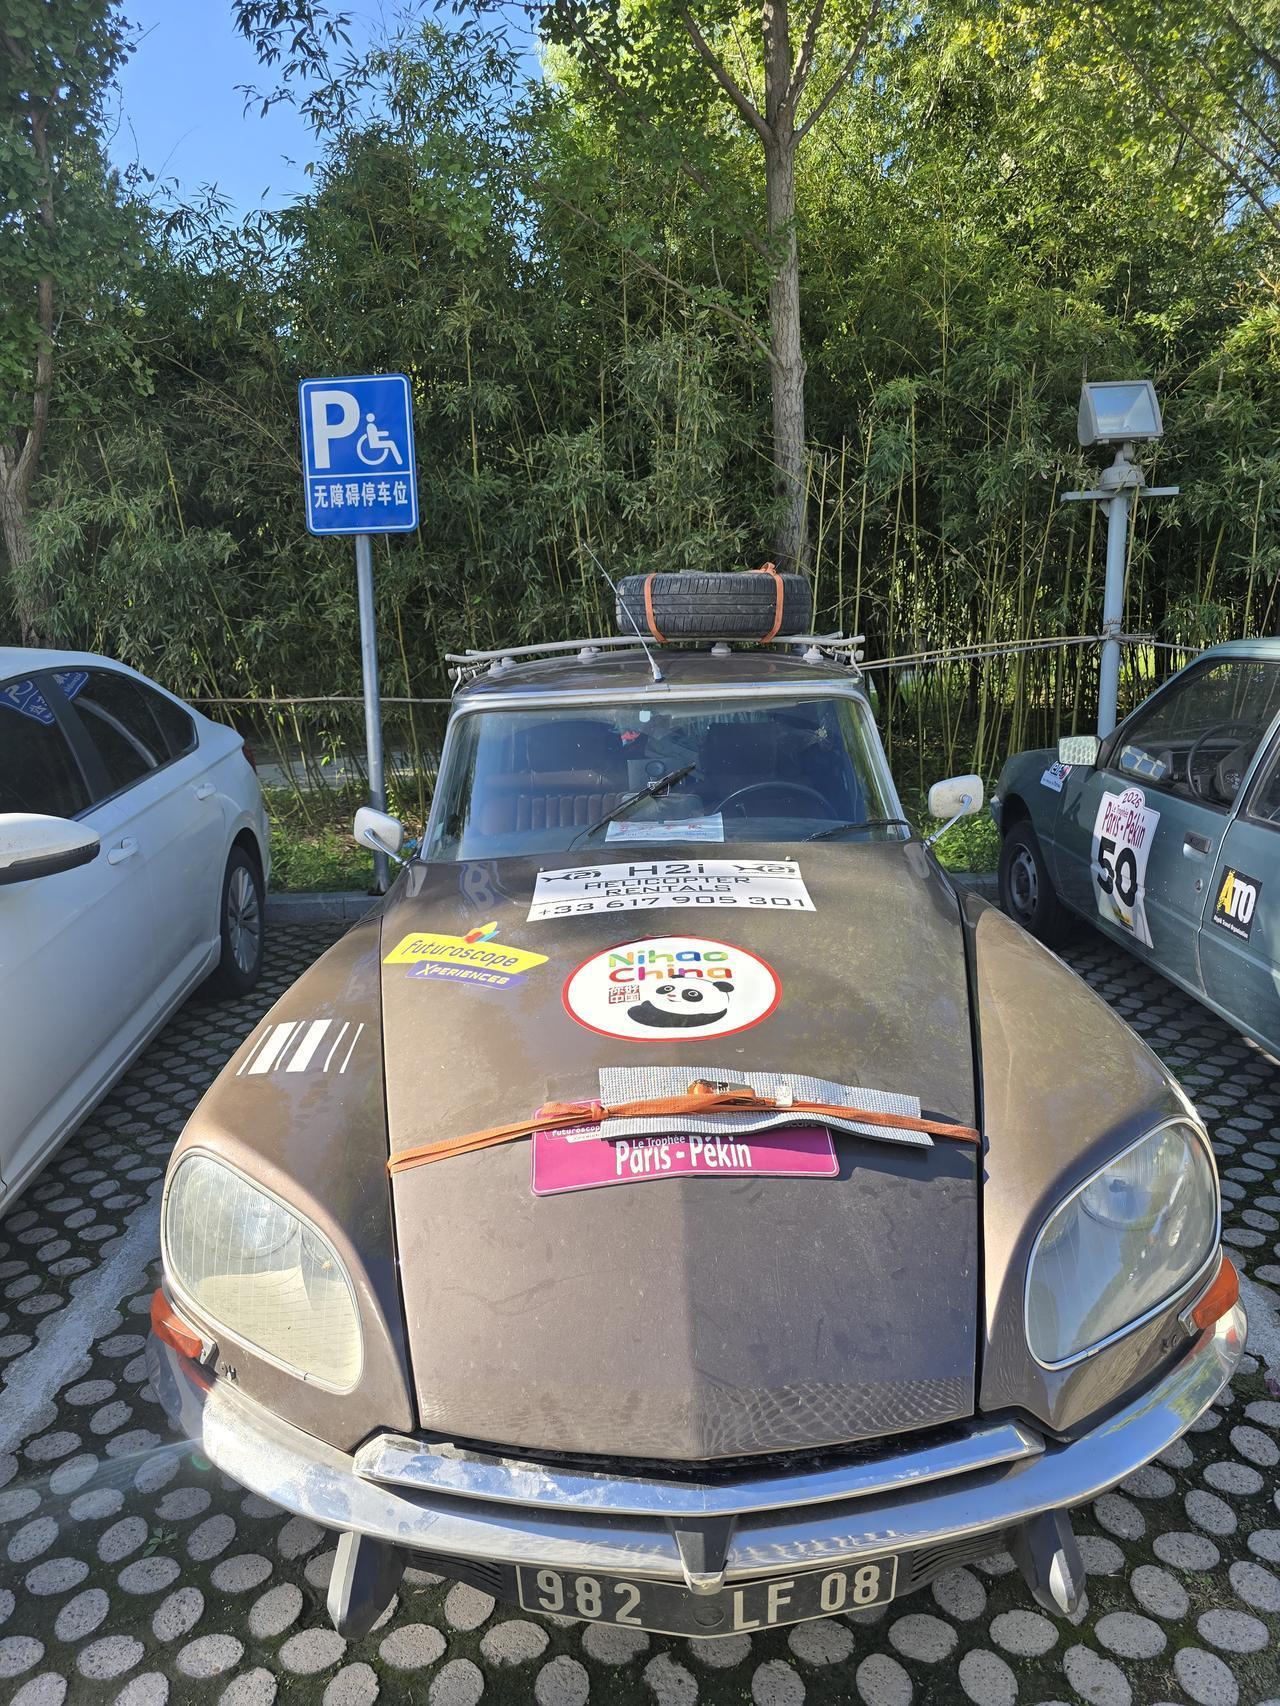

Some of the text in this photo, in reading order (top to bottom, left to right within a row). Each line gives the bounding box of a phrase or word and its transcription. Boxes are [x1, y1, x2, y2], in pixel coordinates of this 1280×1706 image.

[310, 390, 361, 469] P
[314, 481, 408, 508] 无障碍停车位
[1102, 801, 1121, 837] Paris
[629, 863, 704, 877] H2i
[1097, 836, 1137, 907] 50
[584, 877, 750, 890] HELICOPTER
[606, 885, 732, 896] RENTALS
[538, 896, 805, 916] +33 617 905 301
[1217, 870, 1257, 924] ATO
[608, 950, 729, 968] Nihao
[608, 964, 733, 983] China
[551, 1125, 601, 1137] futuroscop
[632, 1135, 686, 1149] Le Trophée
[615, 1140, 671, 1176] Paris
[689, 1135, 752, 1168] Pékin
[536, 1565, 881, 1631] 982 LF 08
